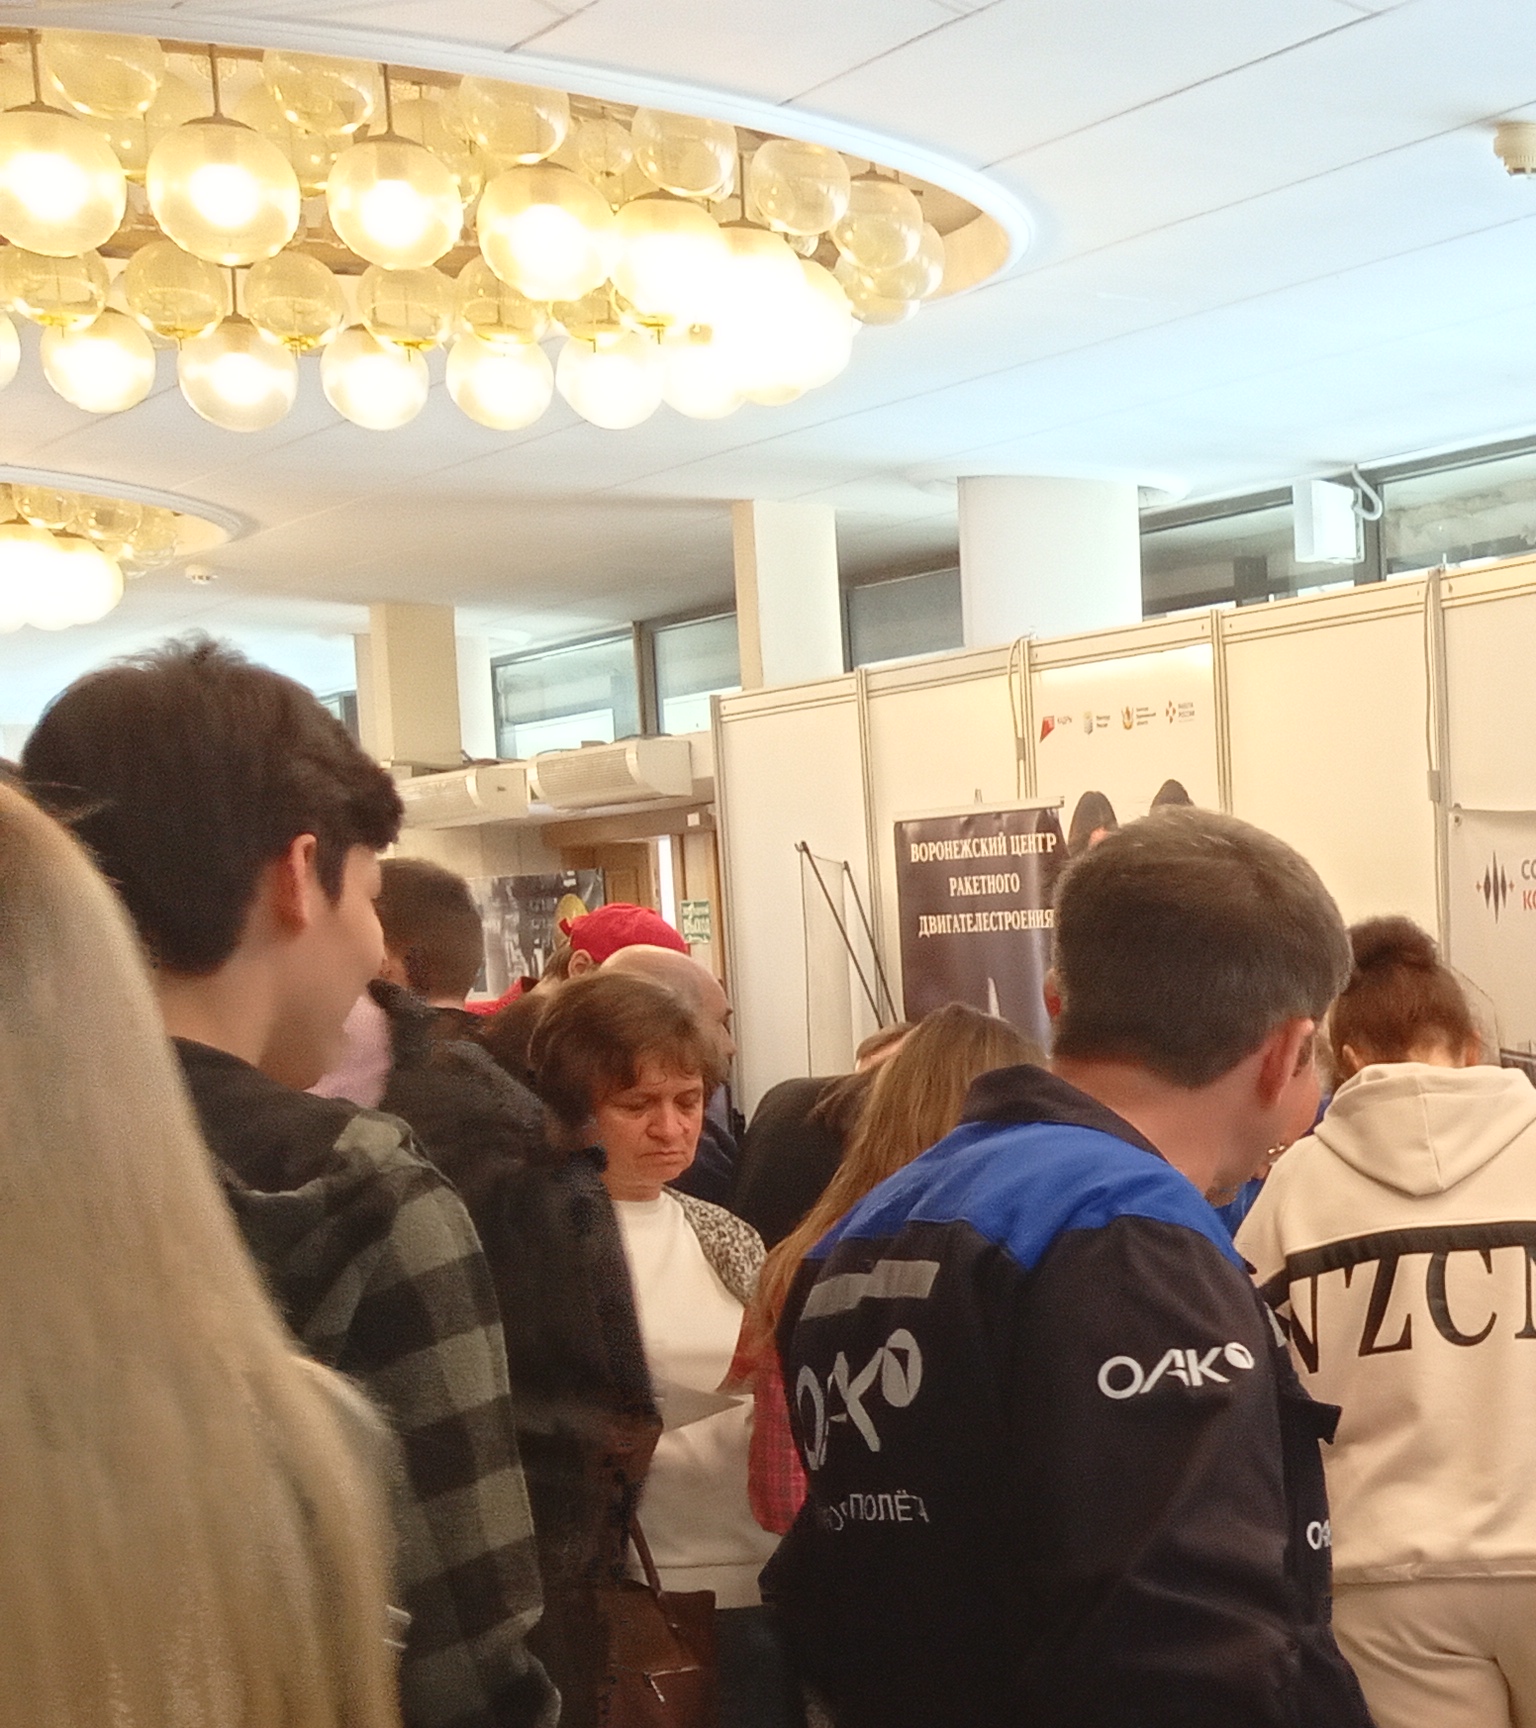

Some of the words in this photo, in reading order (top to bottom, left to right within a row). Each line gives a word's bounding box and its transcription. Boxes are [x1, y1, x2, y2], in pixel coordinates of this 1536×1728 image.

[910, 832, 1007, 863] ВОРОНЕЖСКИЙ
[1009, 832, 1057, 861] ЦЕНТР
[949, 872, 1020, 897] РАКЕТНОГО
[918, 908, 1055, 938] ДВИГАТЕЛЕСТРОЕНИЯ
[1098, 1347, 1231, 1400] ОАК
